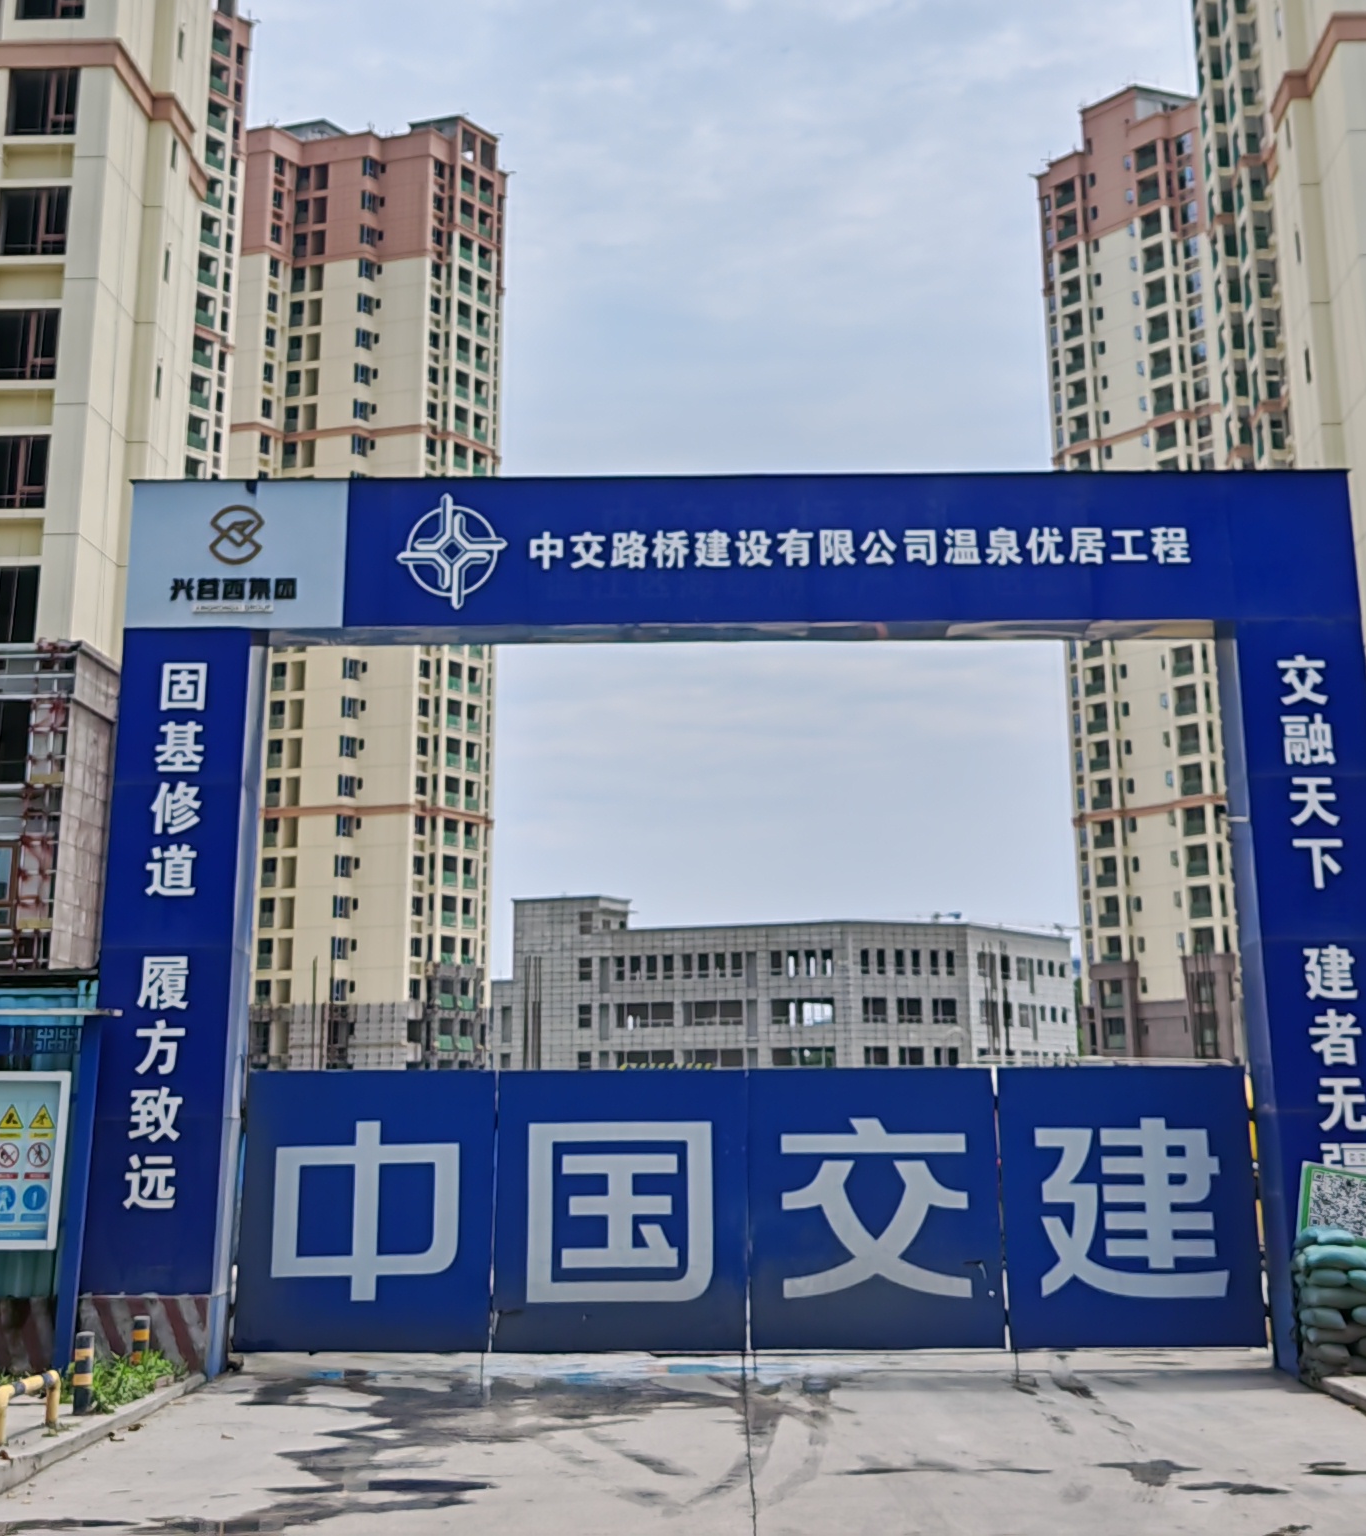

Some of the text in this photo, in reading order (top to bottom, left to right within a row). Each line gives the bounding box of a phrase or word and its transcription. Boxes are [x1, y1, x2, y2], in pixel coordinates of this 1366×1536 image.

[528, 527, 1192, 571] 中交路桥建设有限公司温泉优居工程
[1277, 654, 1343, 889] 交融天下
[123, 662, 208, 1210] 固基修道 履方致远
[270, 1117, 1231, 1303] 中国交建
